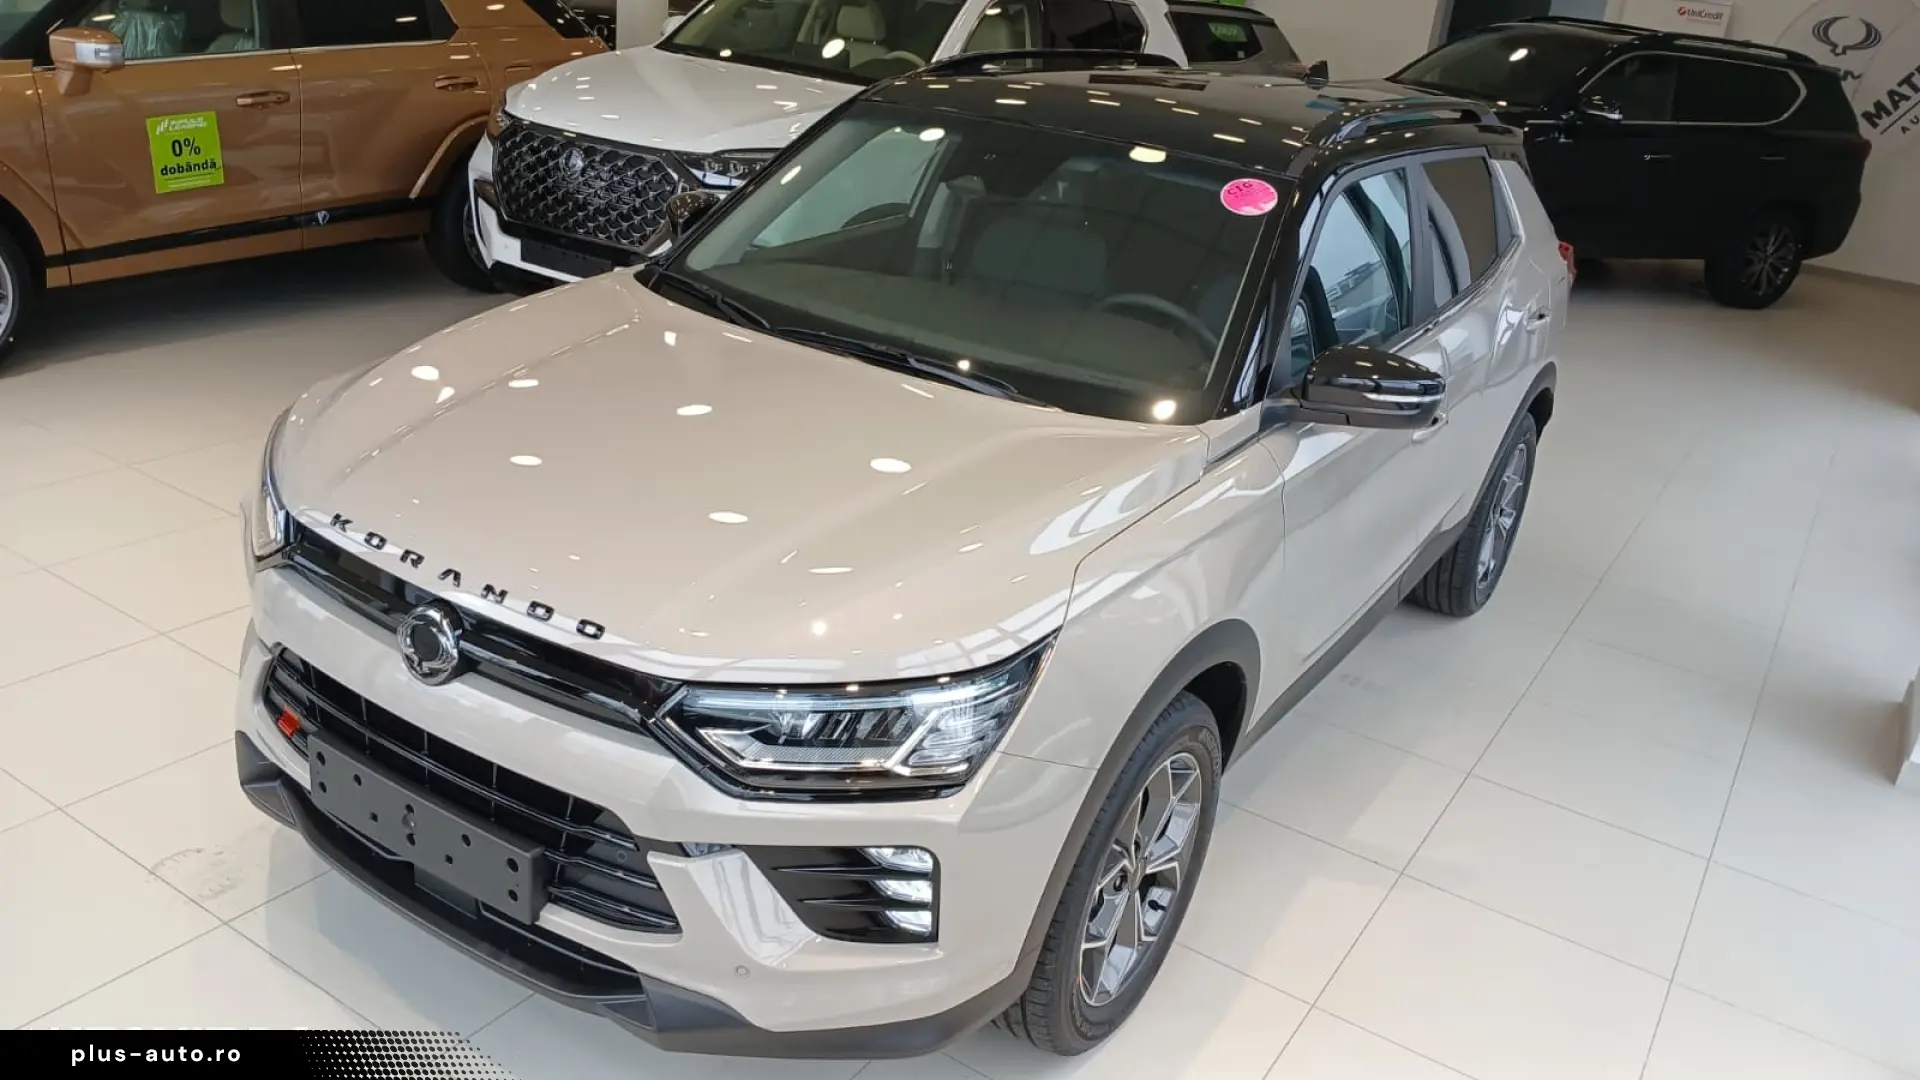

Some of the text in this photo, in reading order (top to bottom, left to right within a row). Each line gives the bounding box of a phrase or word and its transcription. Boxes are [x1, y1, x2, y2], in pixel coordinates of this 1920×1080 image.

[1861, 64, 1920, 129] MAT
[171, 137, 201, 157] 0%
[330, 512, 606, 640] KORANDO
